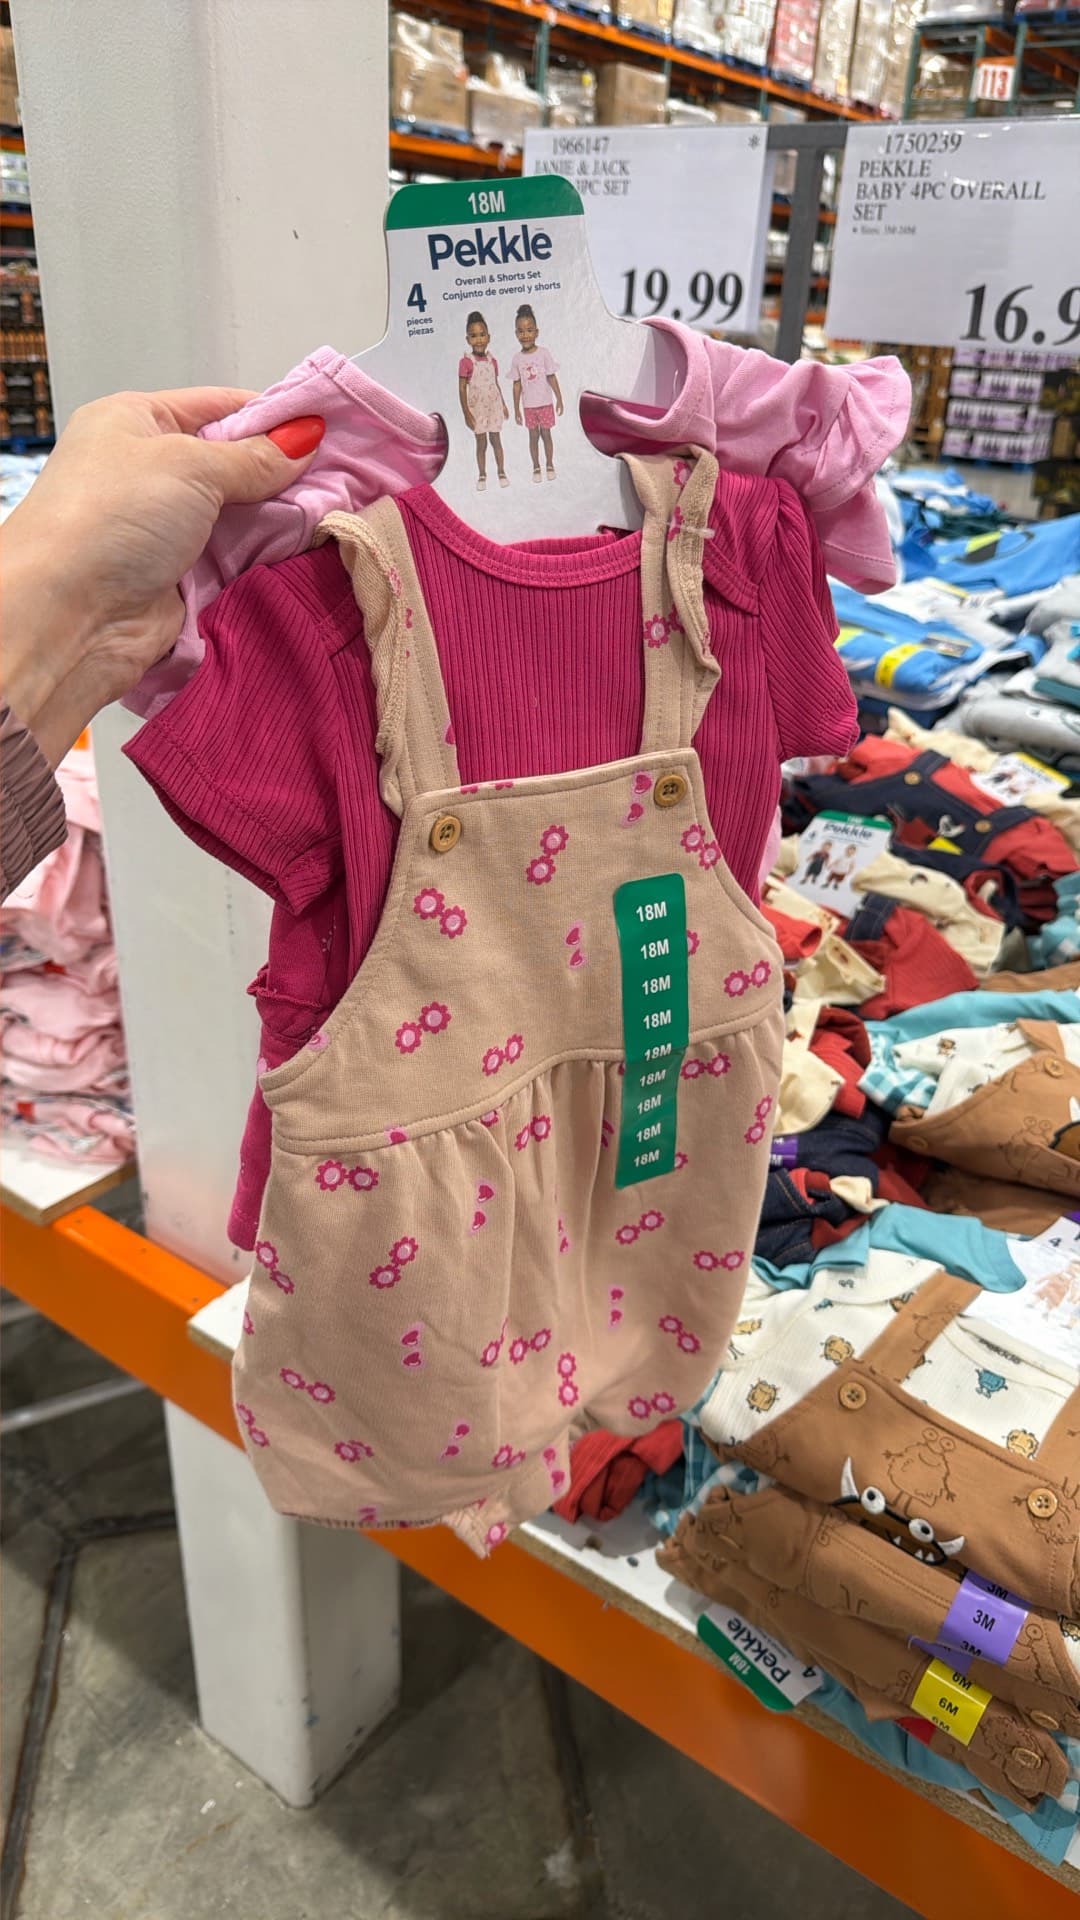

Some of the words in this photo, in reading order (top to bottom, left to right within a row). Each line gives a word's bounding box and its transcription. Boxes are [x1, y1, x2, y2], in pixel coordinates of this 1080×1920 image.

[981, 69, 1009, 99] 113
[552, 135, 610, 156] 1966147
[884, 132, 964, 154] 1750239
[577, 160, 589, 176] &
[592, 159, 631, 176] JACK
[858, 159, 932, 179] PEKKLE
[602, 179, 631, 196] SET
[856, 181, 907, 201] BABY
[911, 182, 946, 200] 4PC
[950, 180, 1047, 201] OVERALL
[467, 190, 506, 215] 18M
[852, 203, 888, 222] SET
[455, 275, 487, 286] Overall
[489, 274, 495, 283] &
[497, 271, 526, 282] Shorts
[527, 270, 541, 280] Set
[406, 282, 428, 313] 4
[442, 289, 484, 302] Conjunto
[485, 288, 497, 297] de
[498, 285, 526, 295] overol
[528, 285, 534, 294] y
[534, 281, 561, 292] shorts
[620, 265, 744, 325] 19.99
[406, 317, 433, 327] pieces
[408, 327, 434, 338] piezas
[636, 901, 667, 922] 18M
[640, 938, 670, 960] 18M
[642, 975, 671, 996] 18M
[643, 1009, 672, 1030] 18M
[644, 1043, 672, 1061] 18M
[640, 1069, 666, 1087] 18M
[637, 1094, 662, 1114] 18M
[636, 1122, 661, 1143] 18M
[634, 1149, 660, 1167] 18M
[972, 1609, 996, 1632] 3M
[727, 1617, 791, 1683] Pekkle
[952, 1671, 973, 1691] 6M
[938, 1697, 959, 1717] 6M
